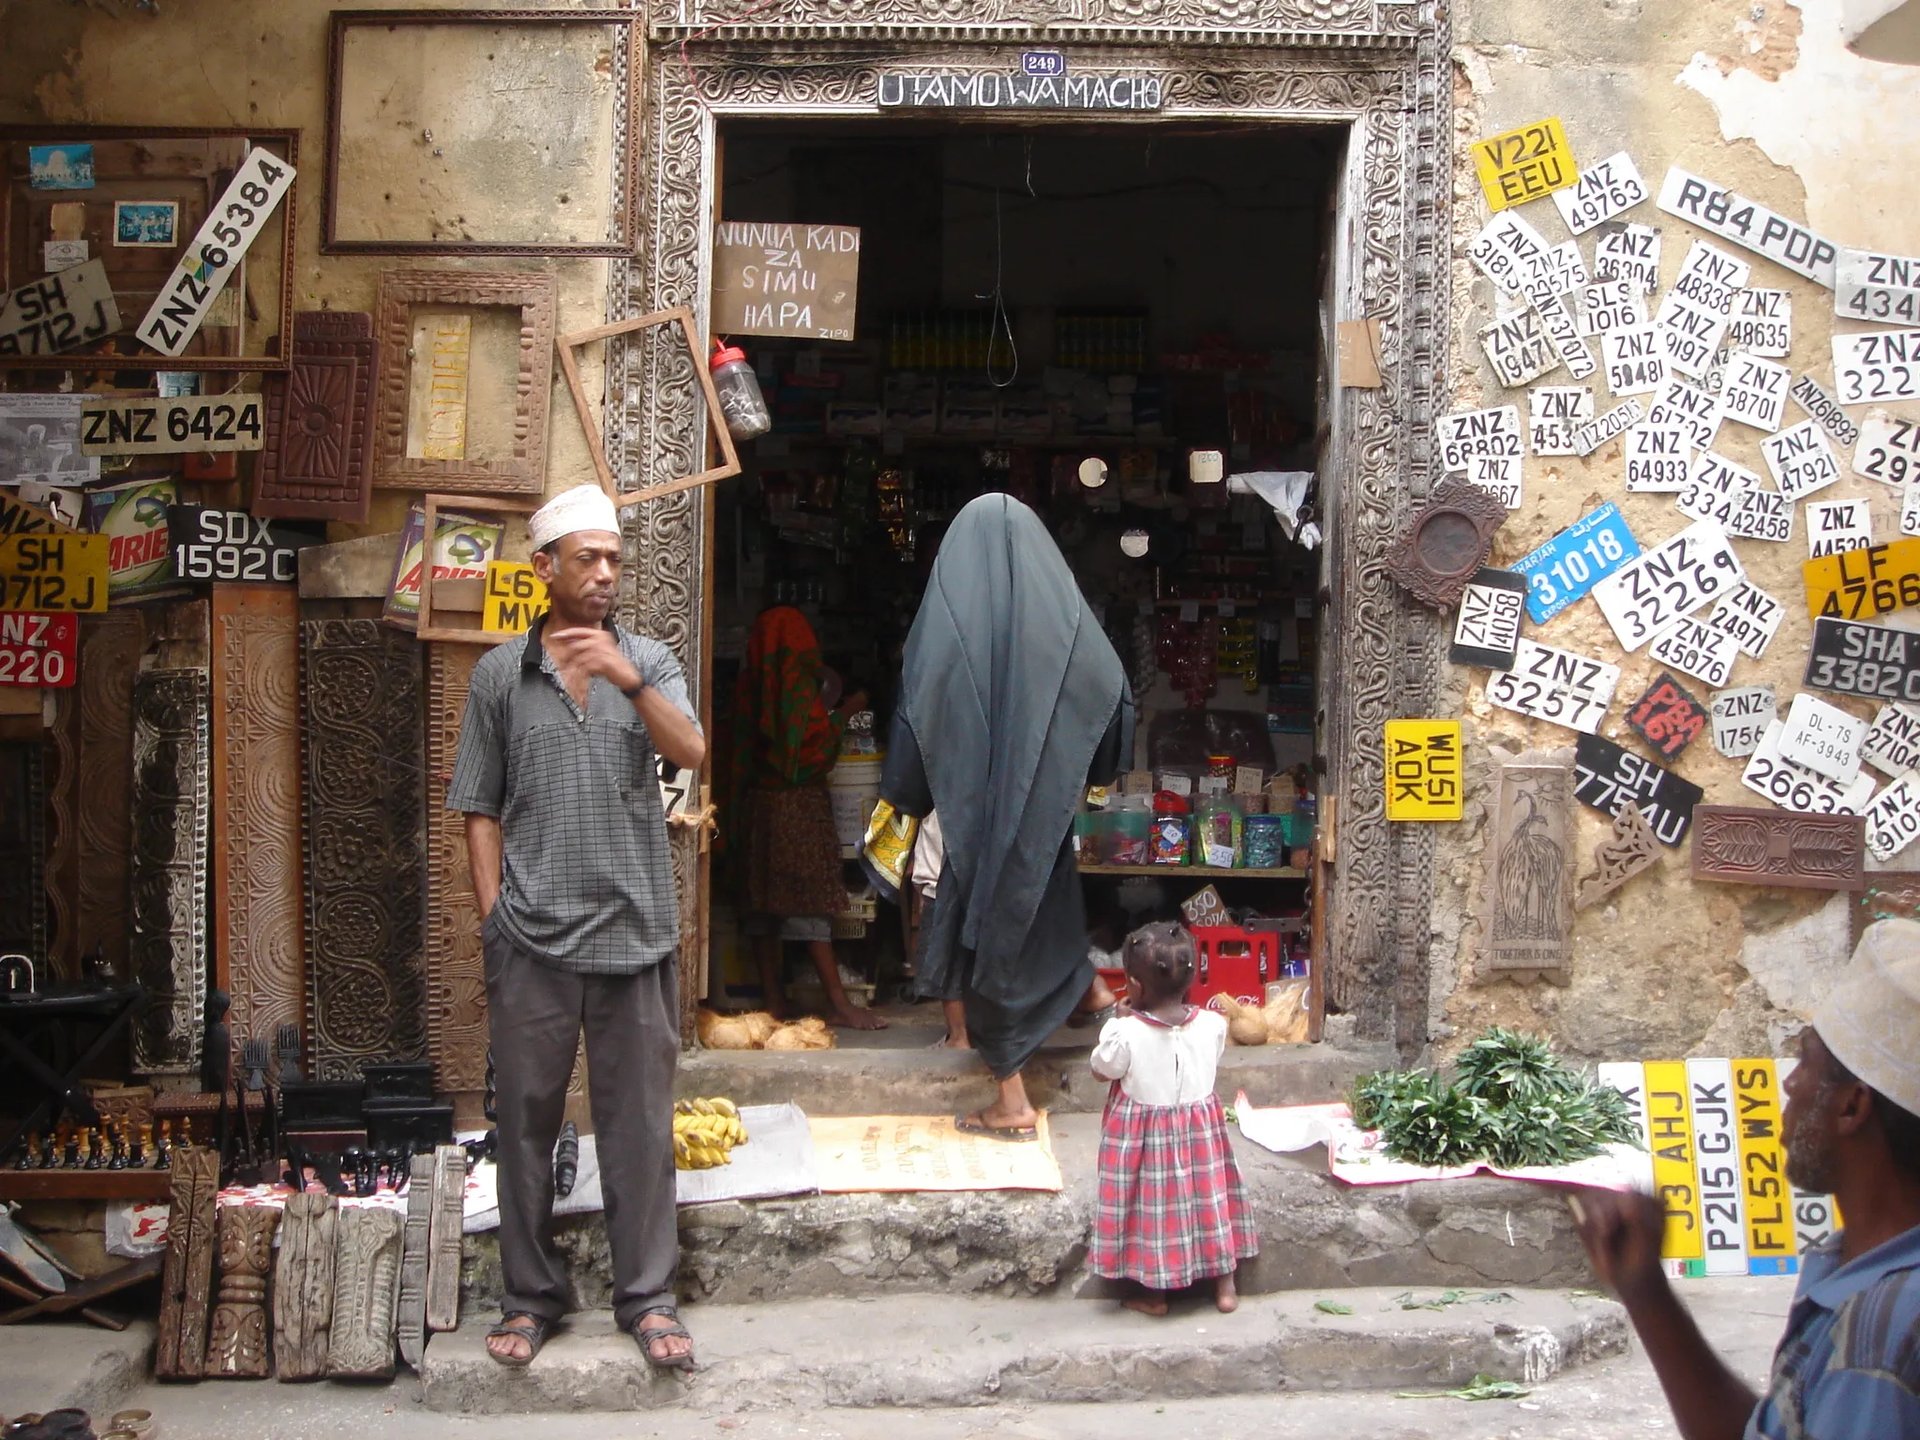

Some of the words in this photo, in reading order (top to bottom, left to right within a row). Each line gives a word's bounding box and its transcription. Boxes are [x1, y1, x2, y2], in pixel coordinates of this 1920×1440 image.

[1028, 56, 1056, 69] 249
[1008, 76, 1060, 105] WA
[1065, 77, 1161, 108] MACHO
[1485, 125, 1557, 169] V221
[1499, 157, 1562, 200] EEU
[1577, 163, 1617, 200] ZNZ
[1572, 180, 1641, 228] 49763
[715, 223, 794, 248] NUNUA
[807, 226, 860, 252] KADI
[1497, 222, 1540, 260] ZNZ
[1677, 179, 1755, 236] R84
[1760, 217, 1835, 269] PDP
[148, 272, 210, 350] ZNZ
[200, 158, 285, 268] 65384
[764, 249, 802, 269] ZA
[1528, 249, 1568, 279] ZNZ
[1607, 233, 1654, 258] ZNZ
[742, 266, 816, 294] SIMU
[1692, 248, 1738, 289] ZNZ
[15, 276, 68, 322] SH
[1586, 283, 1630, 309] SLS
[1676, 273, 1732, 315] 48338
[1740, 290, 1781, 317] ZNZ
[1849, 288, 1920, 321] 434
[744, 302, 812, 328] HAPA
[1486, 311, 1539, 356] ZNZ
[1589, 306, 1636, 332] 1016
[1666, 303, 1716, 342] ZNZ
[1614, 332, 1657, 359] ZNZ
[1666, 332, 1710, 368] 9197
[1730, 321, 1788, 349] 48635
[1860, 333, 1920, 364] ZNZ
[1496, 335, 1557, 384] 19471
[1711, 348, 1730, 368] NZ
[1738, 362, 1782, 394] ZNZ
[1541, 392, 1582, 418] ZNZ
[1667, 384, 1715, 420] ZNZ
[1726, 387, 1777, 422] 58701
[83, 408, 157, 444] ZNZ
[167, 404, 261, 441] 6424
[1453, 411, 1505, 441] ZNZ
[1533, 423, 1588, 449] 453
[1637, 431, 1680, 454] ZNZ
[1446, 434, 1520, 466] 68802
[1771, 427, 1819, 464] ZNZ
[1478, 459, 1510, 480] ZNZ
[1629, 460, 1687, 483] 64933
[1782, 453, 1838, 493] 47921
[1742, 490, 1783, 516] ZNZ
[1820, 506, 1856, 531] ZNZ
[1904, 511, 1920, 531] 5
[200, 510, 274, 545] SDX
[1731, 513, 1790, 540] 42458
[17, 538, 64, 572] SH
[1532, 528, 1624, 605] 31018
[1621, 538, 1697, 601] ZNZ
[1838, 544, 1889, 587] LF
[0, 576, 95, 610] 712J
[1540, 595, 1571, 620] EXPORT
[1623, 550, 1738, 638] 32269
[1732, 582, 1776, 624] ZNZ
[1820, 573, 1920, 619] 4766
[499, 601, 552, 631] MV
[1460, 588, 1493, 644] ZNZ
[1488, 594, 1521, 650] 14058
[1710, 606, 1768, 655] 24971
[1675, 618, 1724, 655] ZNZ
[1843, 626, 1906, 665] SHA
[1529, 647, 1602, 692] ZNZ
[1656, 638, 1726, 683] 45076
[1724, 693, 1762, 717] ZNZ
[1882, 708, 1920, 748] ZNZ
[1864, 728, 1920, 770] 27104
[1395, 739, 1422, 801] AOK
[1427, 733, 1455, 805] WU51
[1614, 752, 1665, 797] SH
[1867, 783, 1913, 829] ZNZ
[1183, 891, 1217, 921] 350
[1694, 1082, 1731, 1154] GJK
[1736, 1068, 1774, 1139] WYS
[1651, 1091, 1689, 1164] AHJ
[1659, 1184, 1695, 1232] J3
[1702, 1167, 1740, 1251] P215
[1746, 1152, 1786, 1250] FL52
